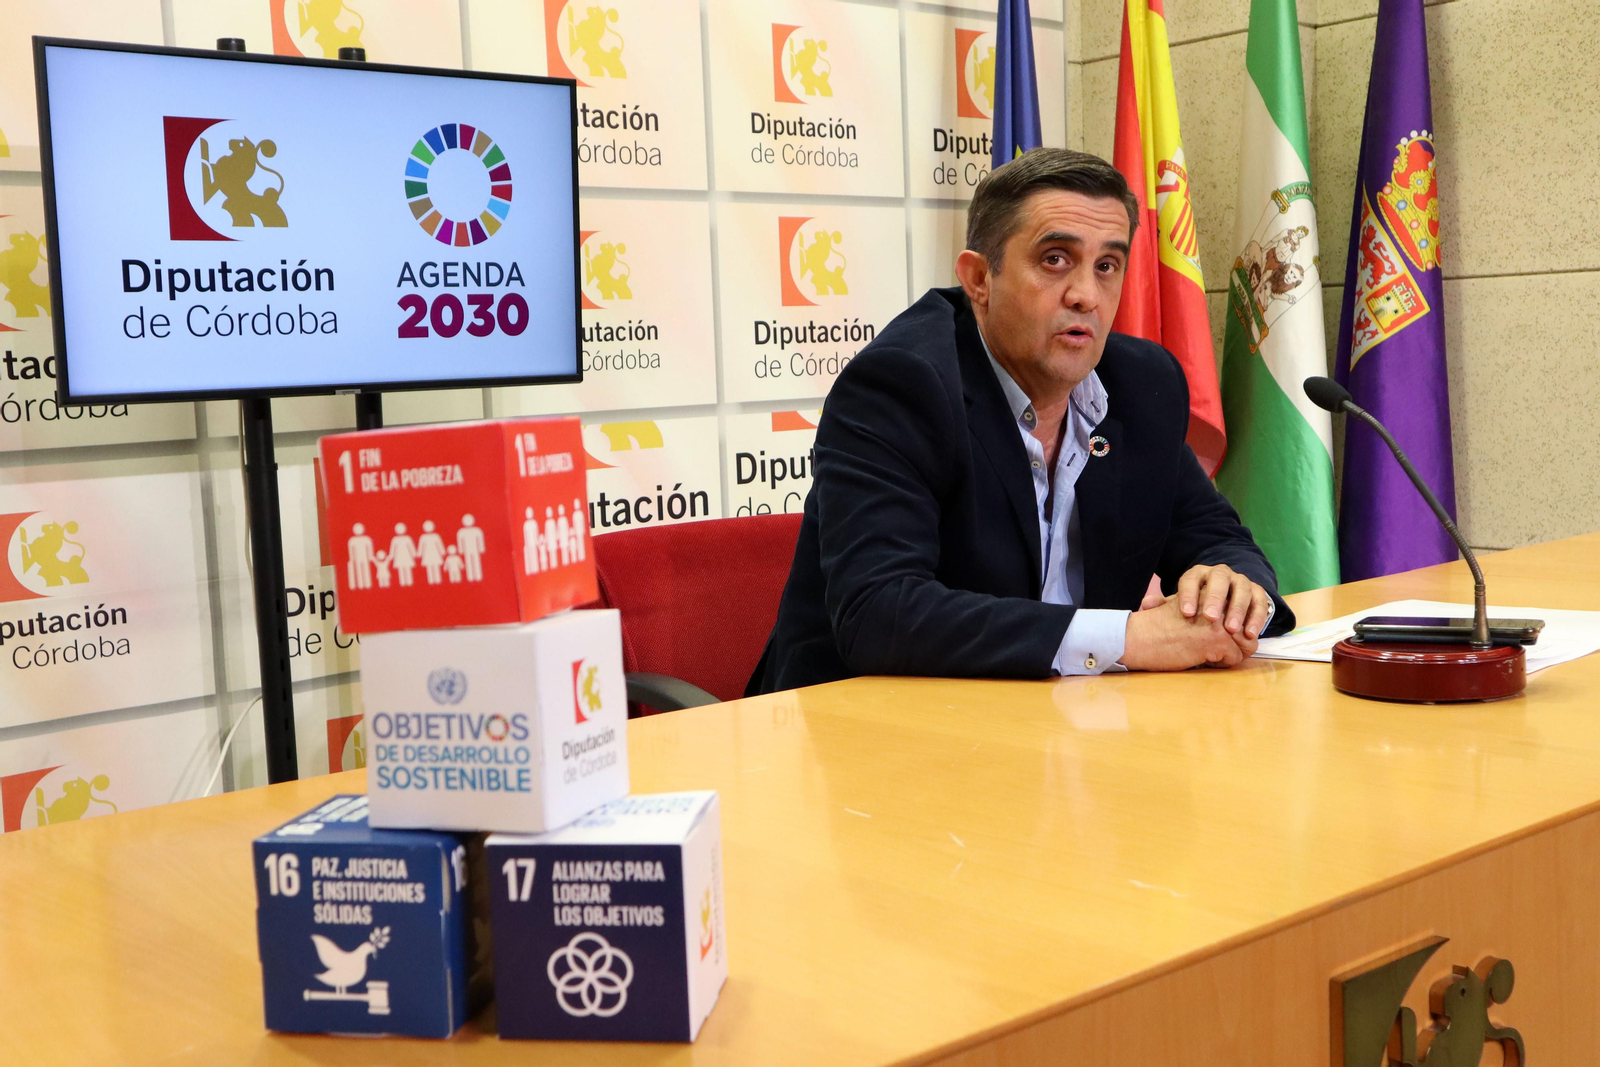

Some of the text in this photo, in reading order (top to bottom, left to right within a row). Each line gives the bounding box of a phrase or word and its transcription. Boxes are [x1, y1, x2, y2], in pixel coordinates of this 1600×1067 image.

[577, 103, 659, 131] tación
[751, 112, 857, 140] Diputación
[751, 142, 859, 168] de Córdoba
[933, 128, 993, 159] Diput
[933, 161, 957, 185] de
[121, 259, 335, 301] Diputación
[396, 261, 526, 288] AGENDA
[123, 304, 338, 338] de Córdoba
[397, 292, 530, 338] 2030
[754, 318, 875, 350] Diputación
[754, 354, 782, 379] de
[338, 449, 354, 494] 1
[359, 447, 382, 469] FIN
[360, 463, 465, 493] DE LA POBREZA
[12, 636, 130, 669] Córdoba
[288, 628, 322, 658] de
[372, 712, 530, 742] OBJETIVOS
[375, 744, 530, 765] DE DESARROLLO
[377, 765, 531, 792] SOSTENIBLE
[264, 853, 301, 897] 16
[312, 856, 409, 879] PAZ, JUSTICIA
[502, 858, 537, 902] 17
[552, 860, 666, 882] ALIANZAS PARA
[312, 880, 426, 903] E INSTITUCIONES
[552, 883, 612, 904] LOGRAR
[313, 901, 373, 925] SÓLIDAS
[553, 905, 665, 927] LOS OBJETIVOS
